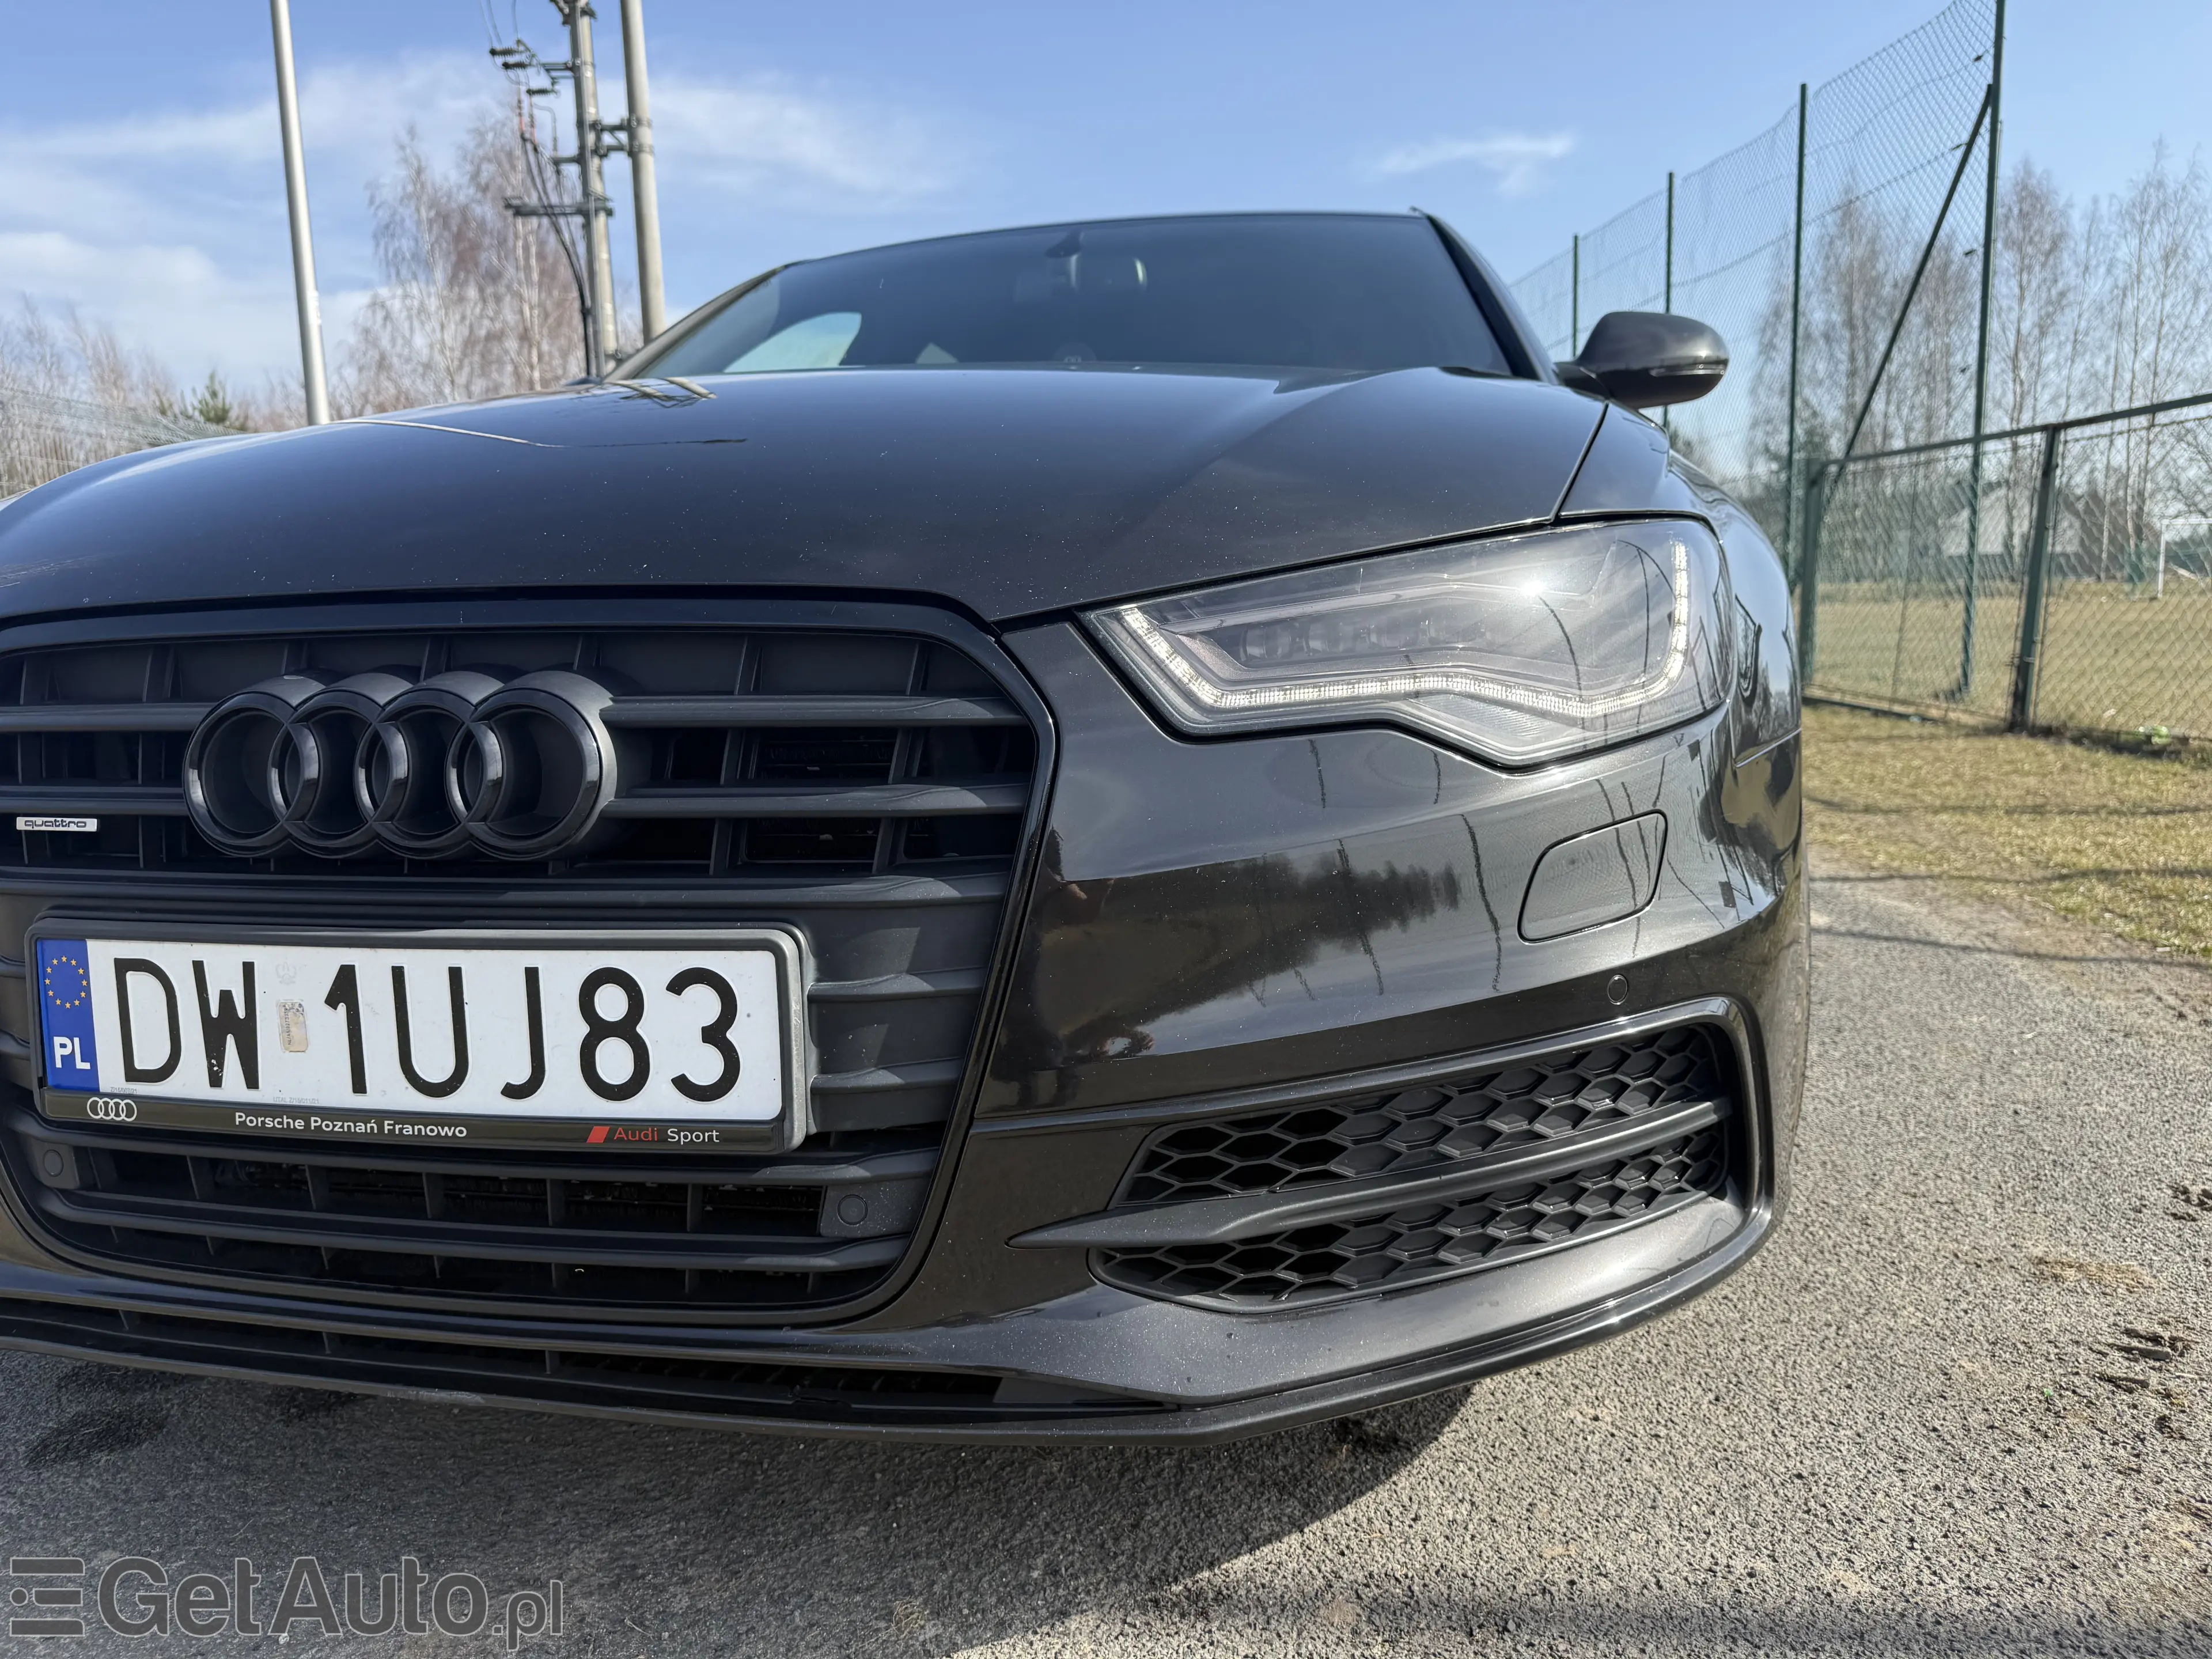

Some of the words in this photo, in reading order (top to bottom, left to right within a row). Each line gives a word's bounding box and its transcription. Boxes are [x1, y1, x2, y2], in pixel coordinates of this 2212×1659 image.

[24, 819, 87, 828] quattro
[114, 957, 260, 1090] DW
[324, 964, 741, 1102] 1UJ83
[53, 1036, 91, 1070] PL
[235, 1112, 305, 1130] Porsche
[310, 1116, 377, 1134] Poznań
[384, 1120, 467, 1137] Franowo
[613, 1127, 658, 1142] Audi
[667, 1128, 719, 1145] Sport
